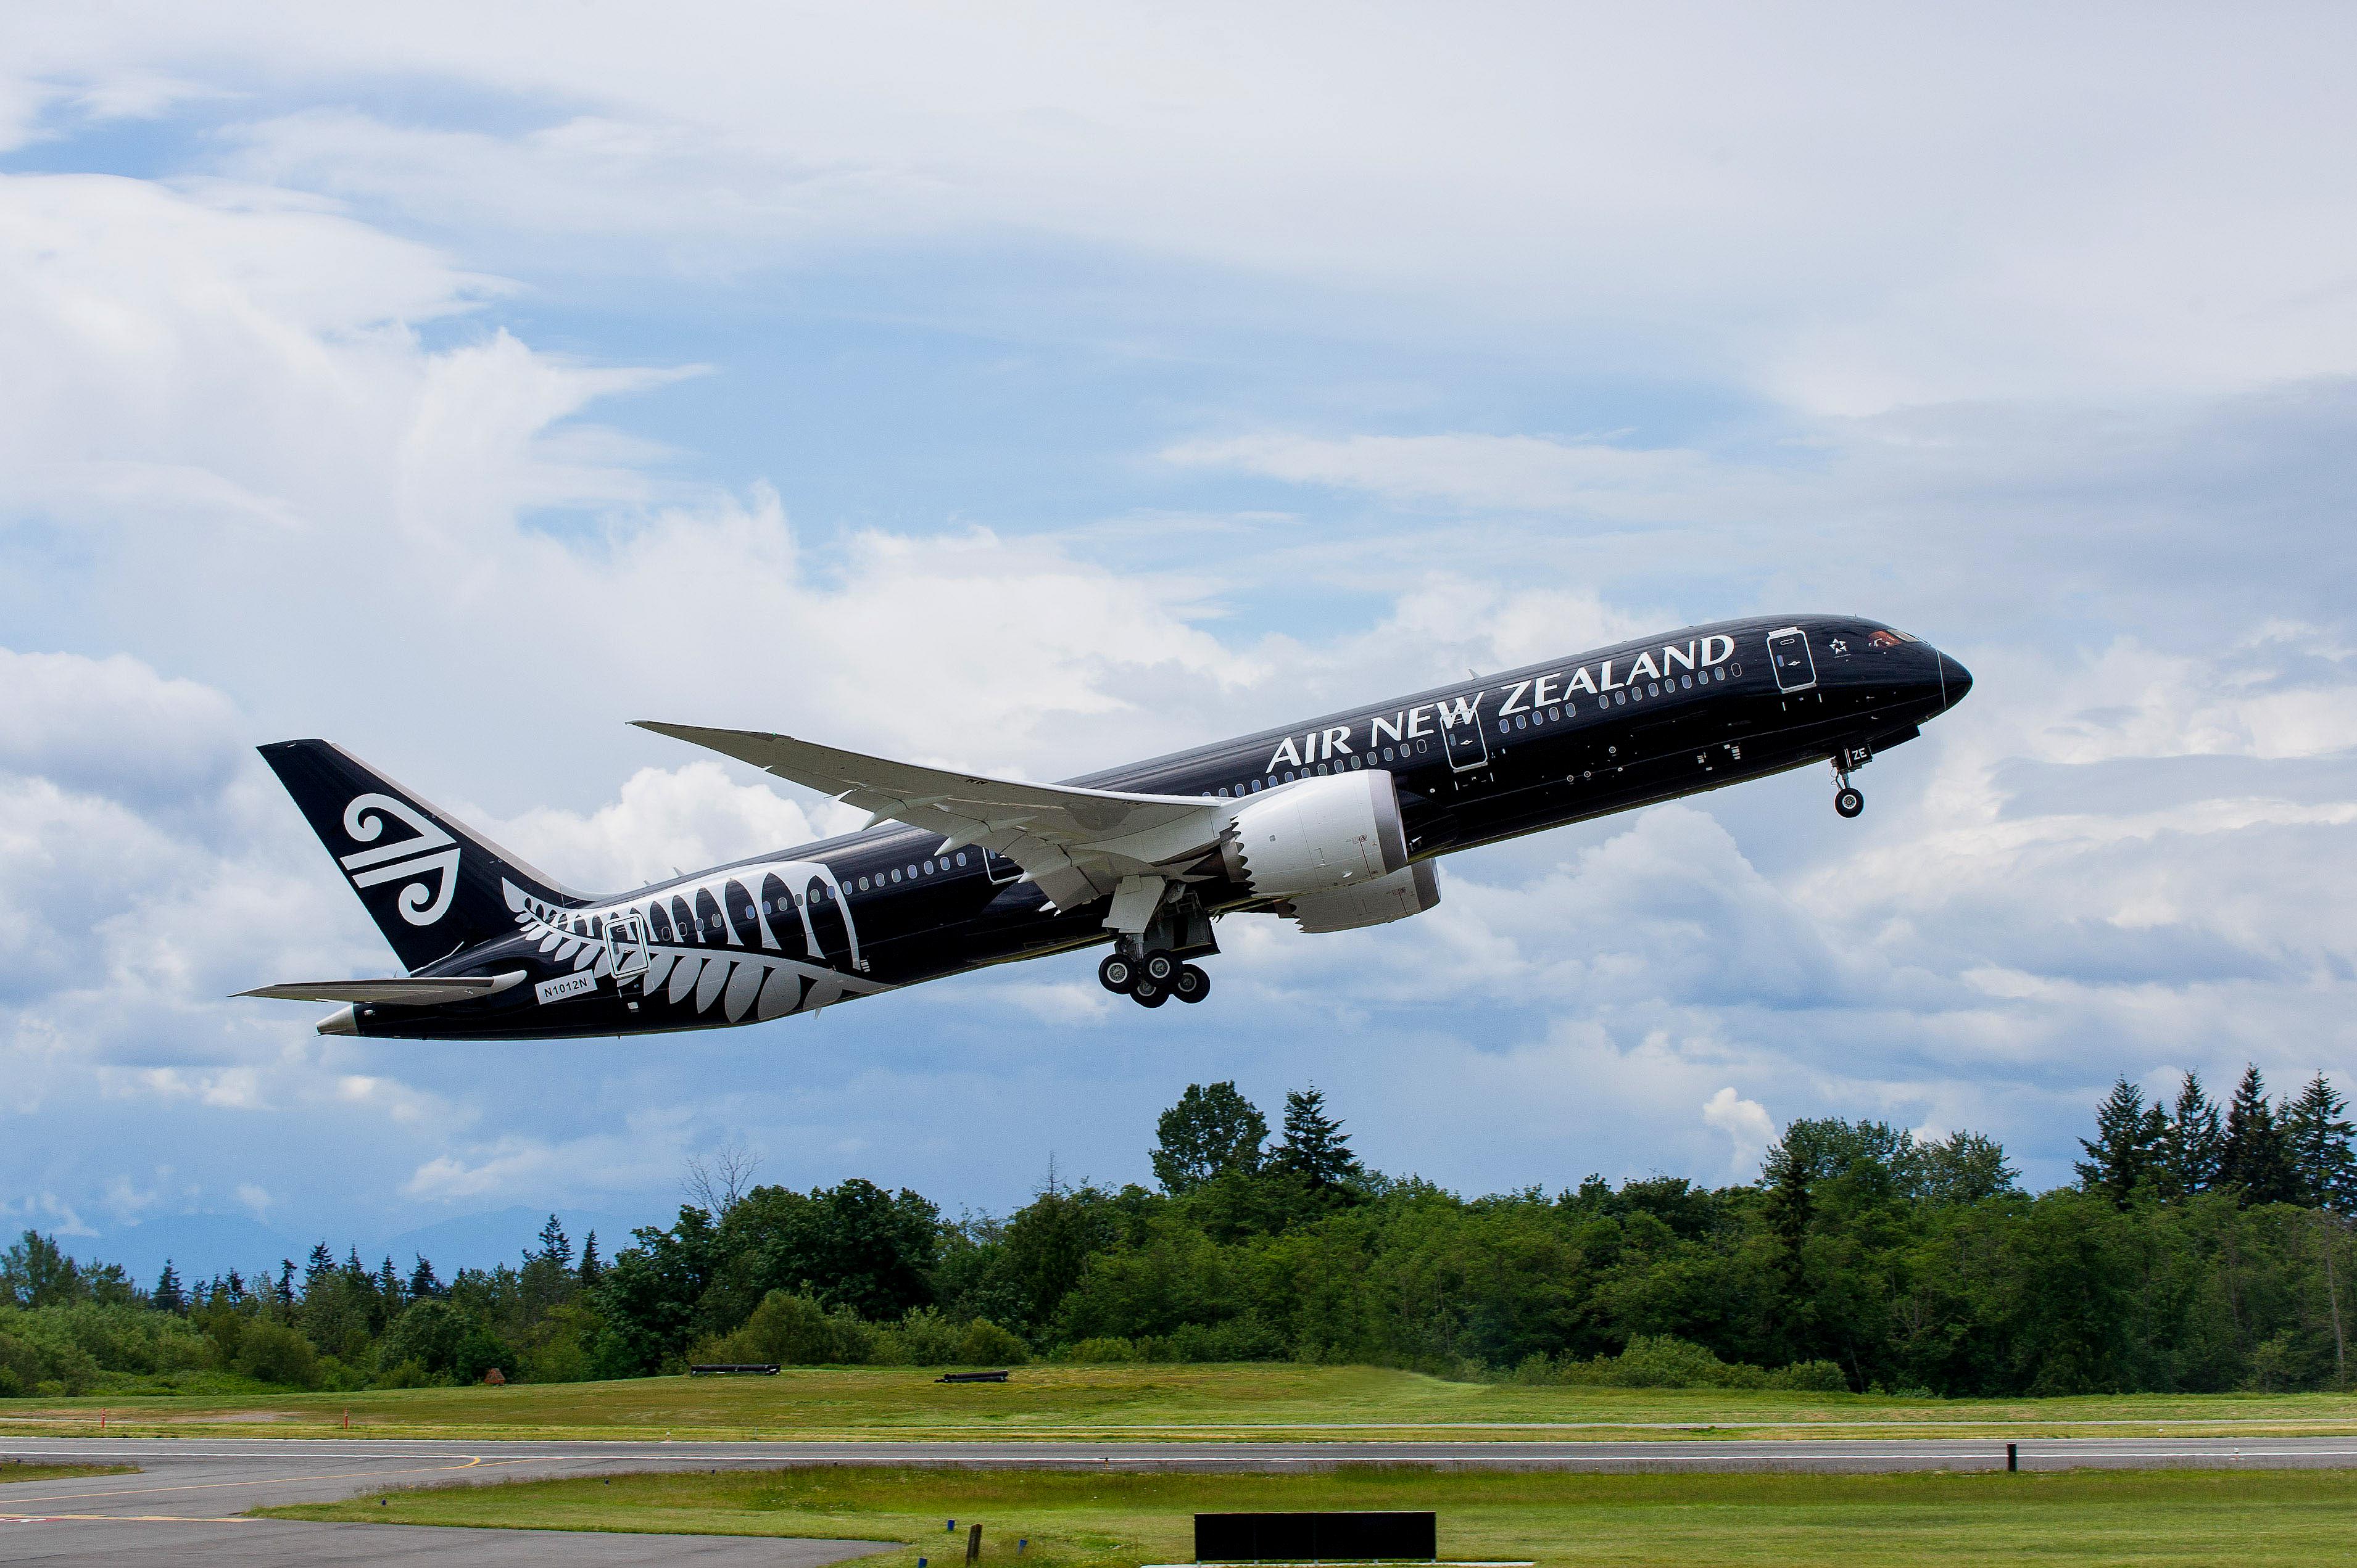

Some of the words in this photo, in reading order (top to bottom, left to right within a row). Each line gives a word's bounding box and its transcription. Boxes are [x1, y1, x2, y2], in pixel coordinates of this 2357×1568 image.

[1266, 726, 1353, 774] AIR
[1371, 691, 1485, 748] NEW
[1498, 635, 1734, 717] ZEALAND
[1852, 748, 1867, 760] ZE
[544, 978, 587, 997] N1012N
